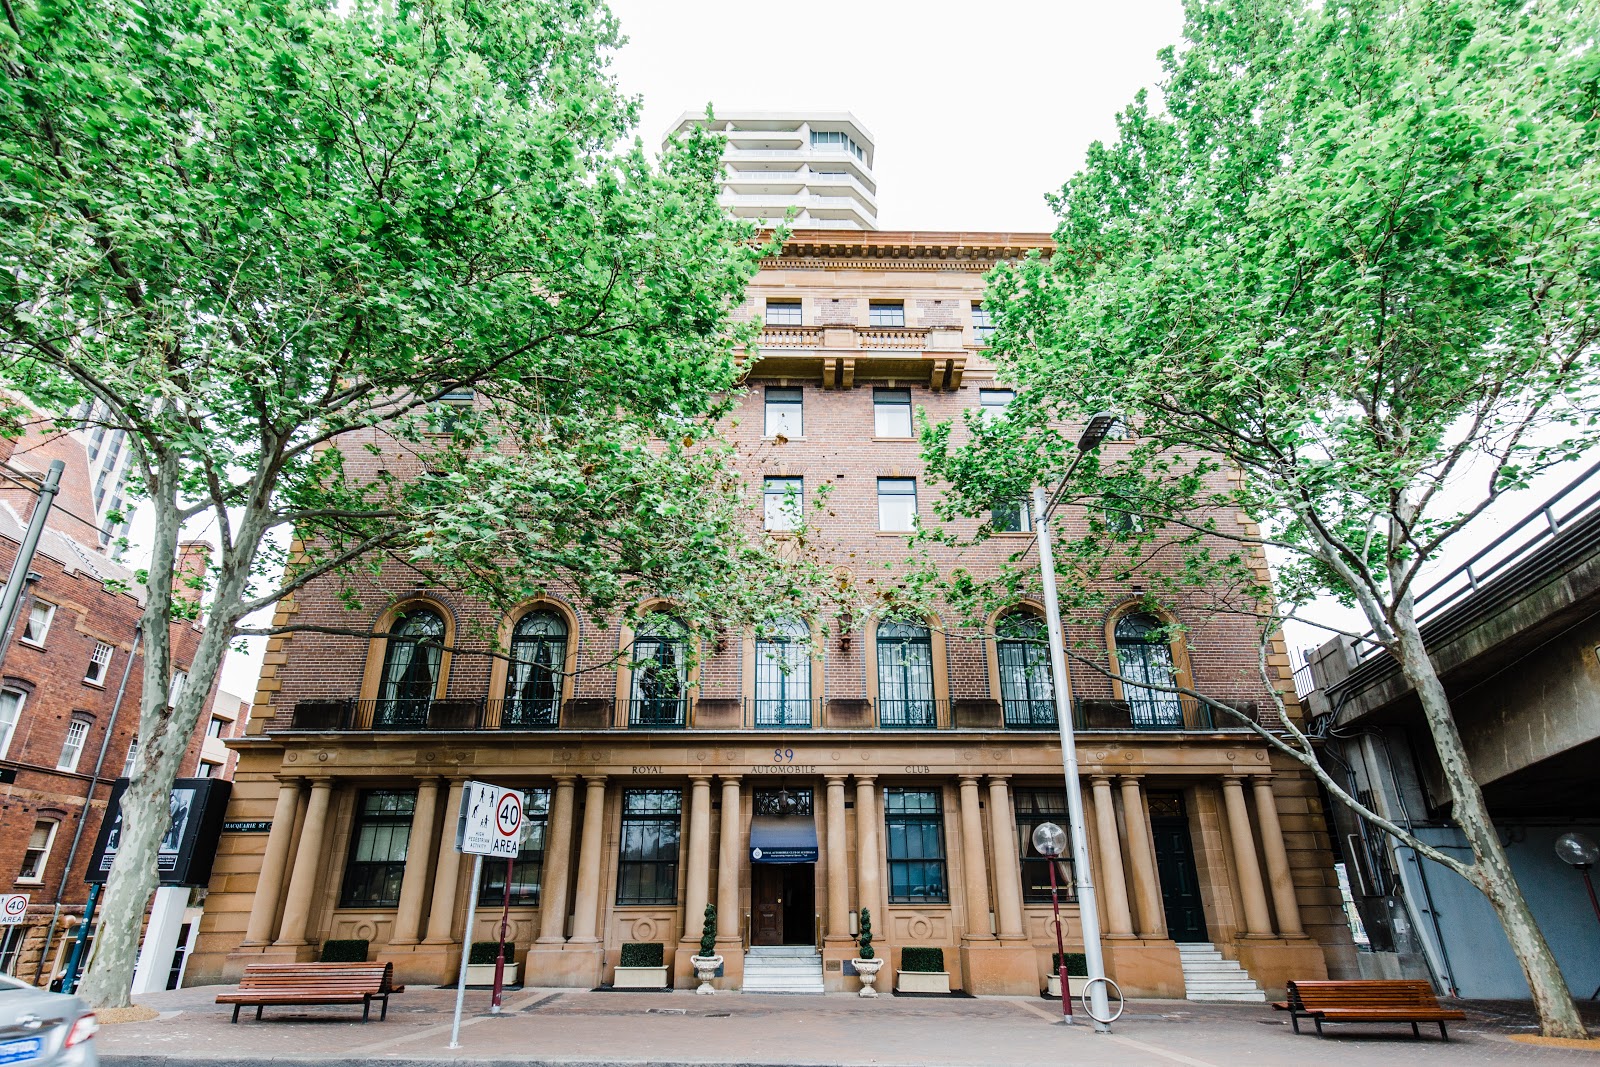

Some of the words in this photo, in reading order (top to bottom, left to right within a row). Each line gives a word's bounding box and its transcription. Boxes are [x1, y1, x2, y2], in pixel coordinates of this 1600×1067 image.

[773, 748, 794, 763] 89
[632, 766, 664, 774] ROYAL
[751, 766, 816, 774] AUTOMOBILE
[905, 765, 930, 774] CLUB
[500, 804, 519, 826] 40
[492, 838, 517, 854] AREA
[9, 900, 24, 910] 40
